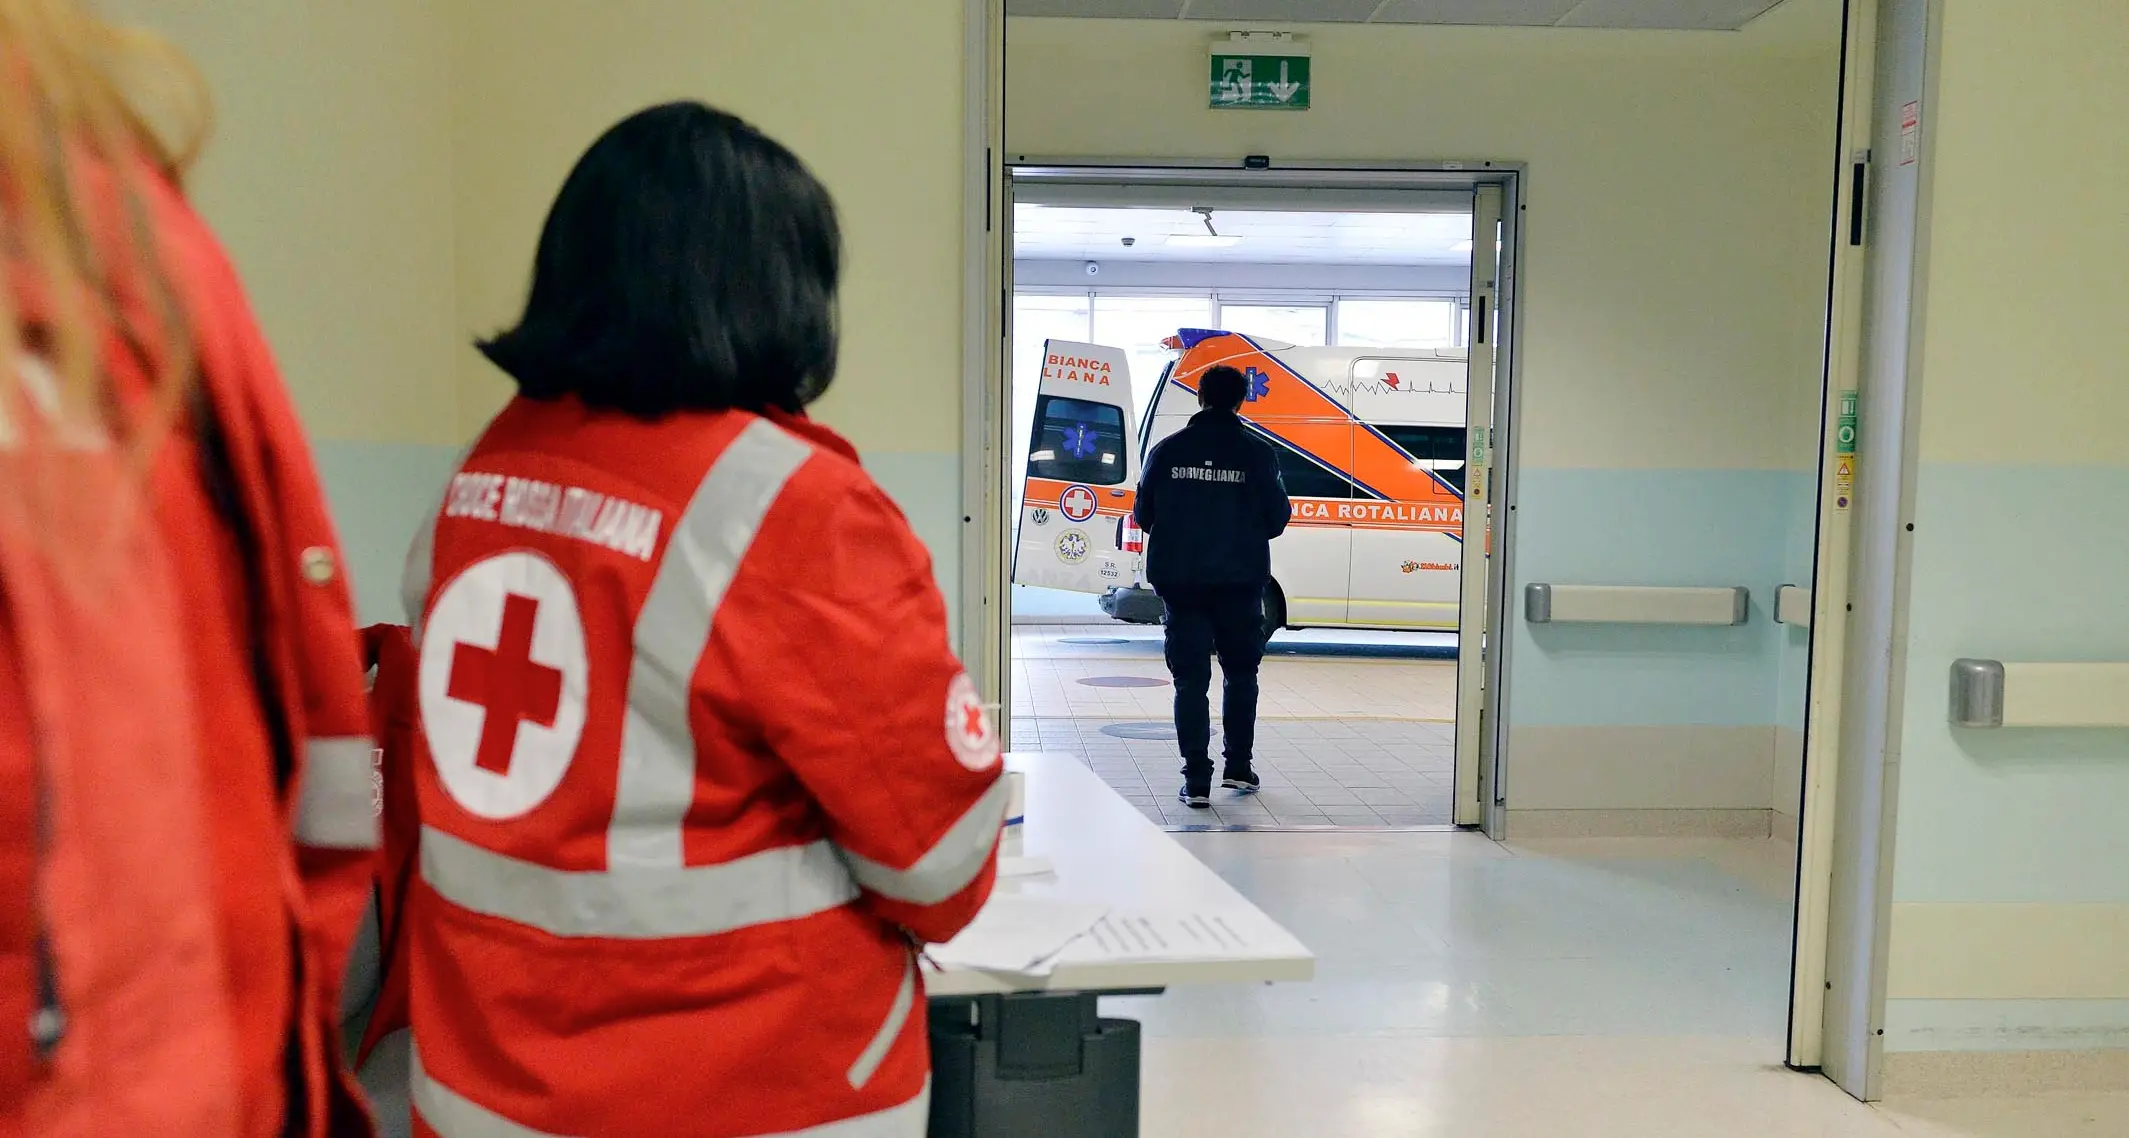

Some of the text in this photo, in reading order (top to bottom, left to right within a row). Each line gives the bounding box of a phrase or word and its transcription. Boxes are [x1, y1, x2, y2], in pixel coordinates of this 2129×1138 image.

[1048, 354, 1111, 373] BIANCA
[1043, 367, 1110, 386] LIANA
[1171, 466, 1246, 483] SORVEGLIANZA
[1338, 503, 1462, 522] ROTALIANA
